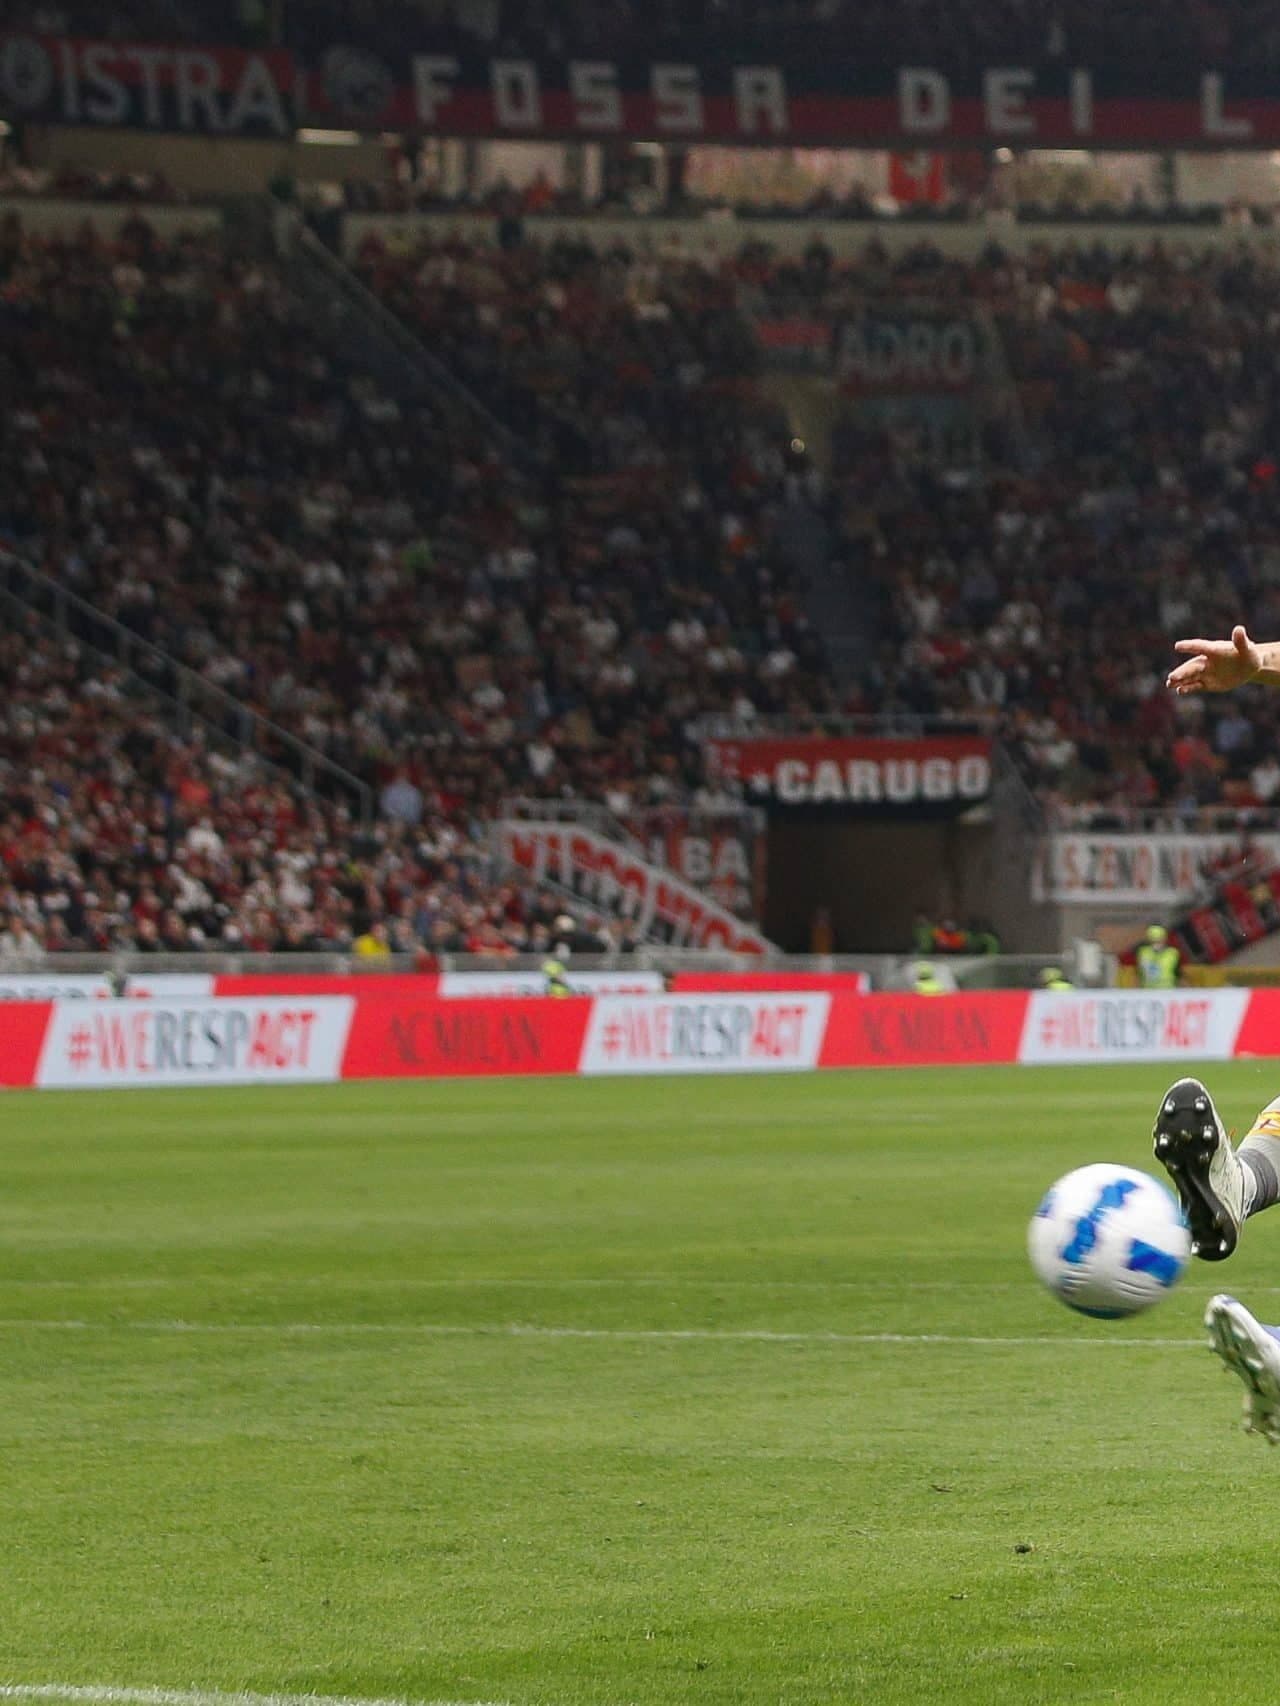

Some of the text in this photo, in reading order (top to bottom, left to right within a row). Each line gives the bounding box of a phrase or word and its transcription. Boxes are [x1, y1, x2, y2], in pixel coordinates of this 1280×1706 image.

[411, 55, 788, 132] FOSSA
[899, 67, 1094, 133] DEI
[774, 756, 991, 803] CARUGO
[67, 1008, 317, 1072] #WERESPACT
[602, 1004, 808, 1061] #WERESPACT
[1040, 1000, 1213, 1050] #WERESPACT
